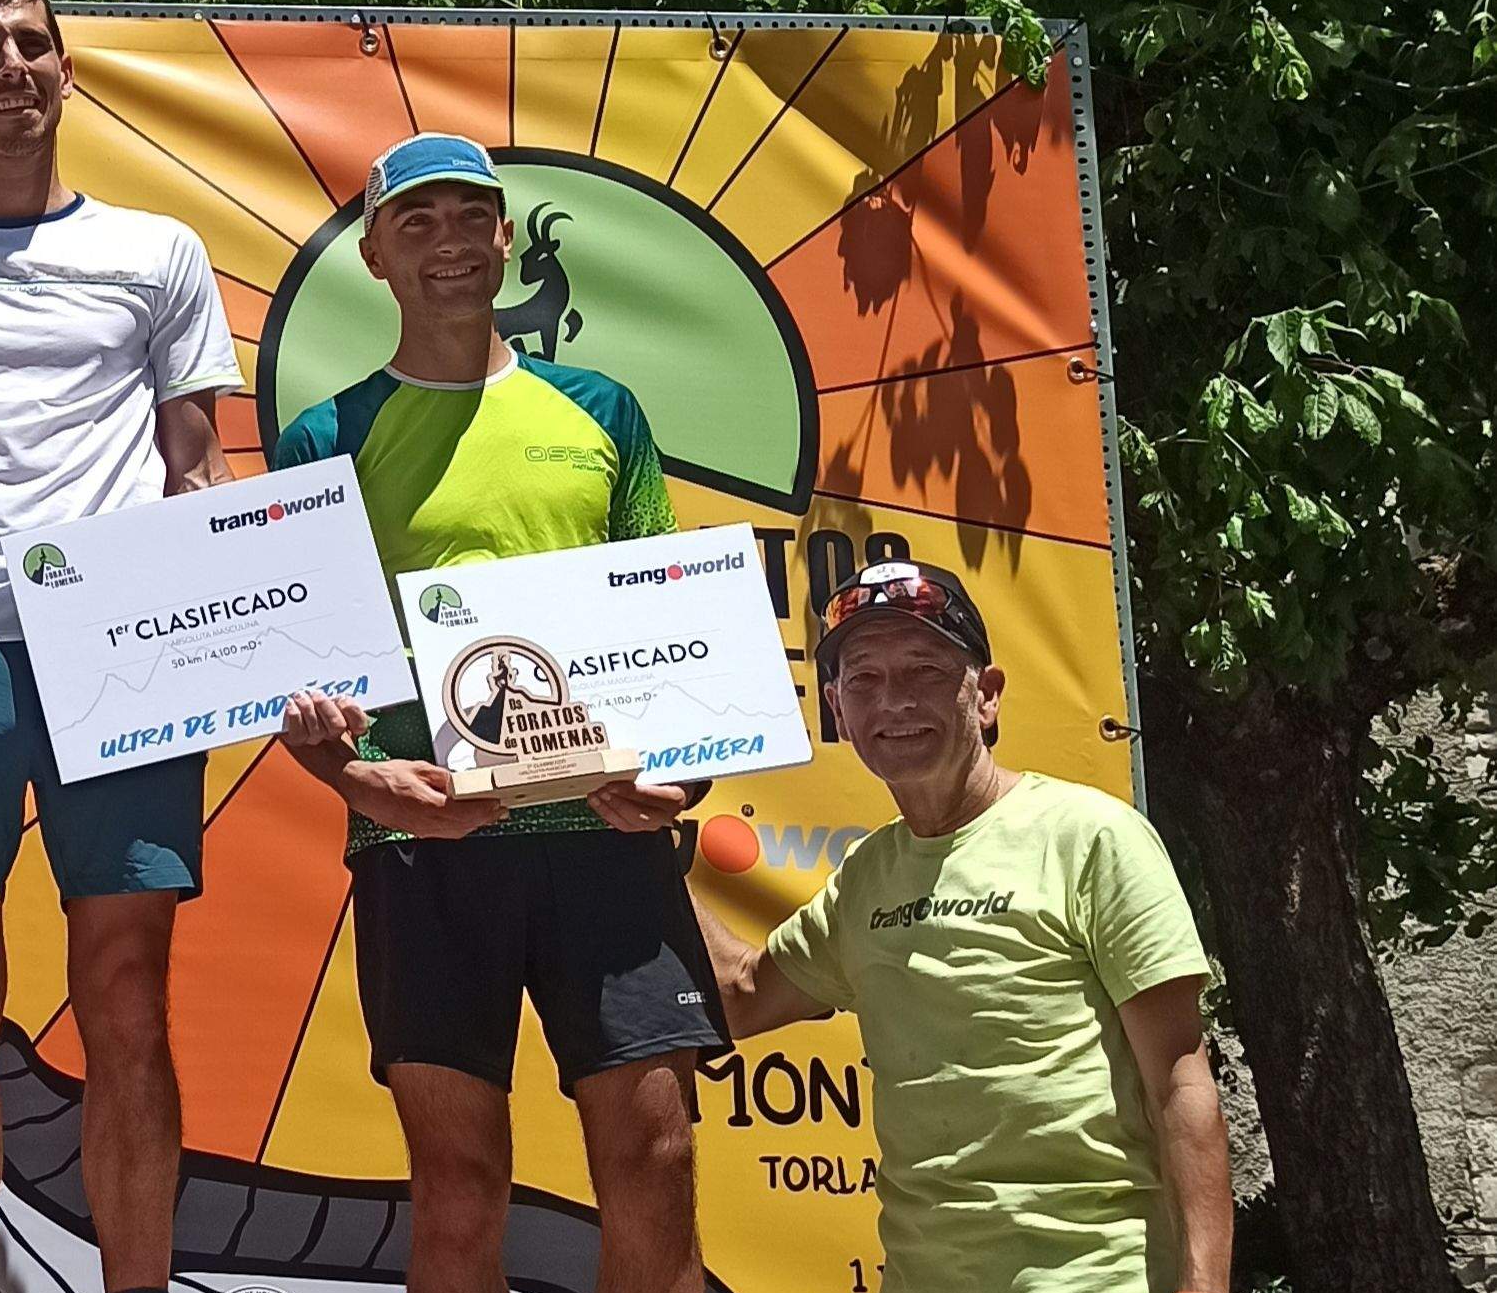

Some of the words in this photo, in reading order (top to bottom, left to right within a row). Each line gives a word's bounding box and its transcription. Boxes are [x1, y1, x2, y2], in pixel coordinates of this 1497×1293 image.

[135, 582, 308, 641] CLASIFICADO
[171, 658, 185, 669] 50
[508, 698, 523, 711] Os
[506, 705, 586, 734] FORATOS
[100, 722, 175, 759] ULTRA
[183, 710, 217, 739] DE
[504, 736, 518, 749] de
[520, 725, 605, 755] LOMENÁS
